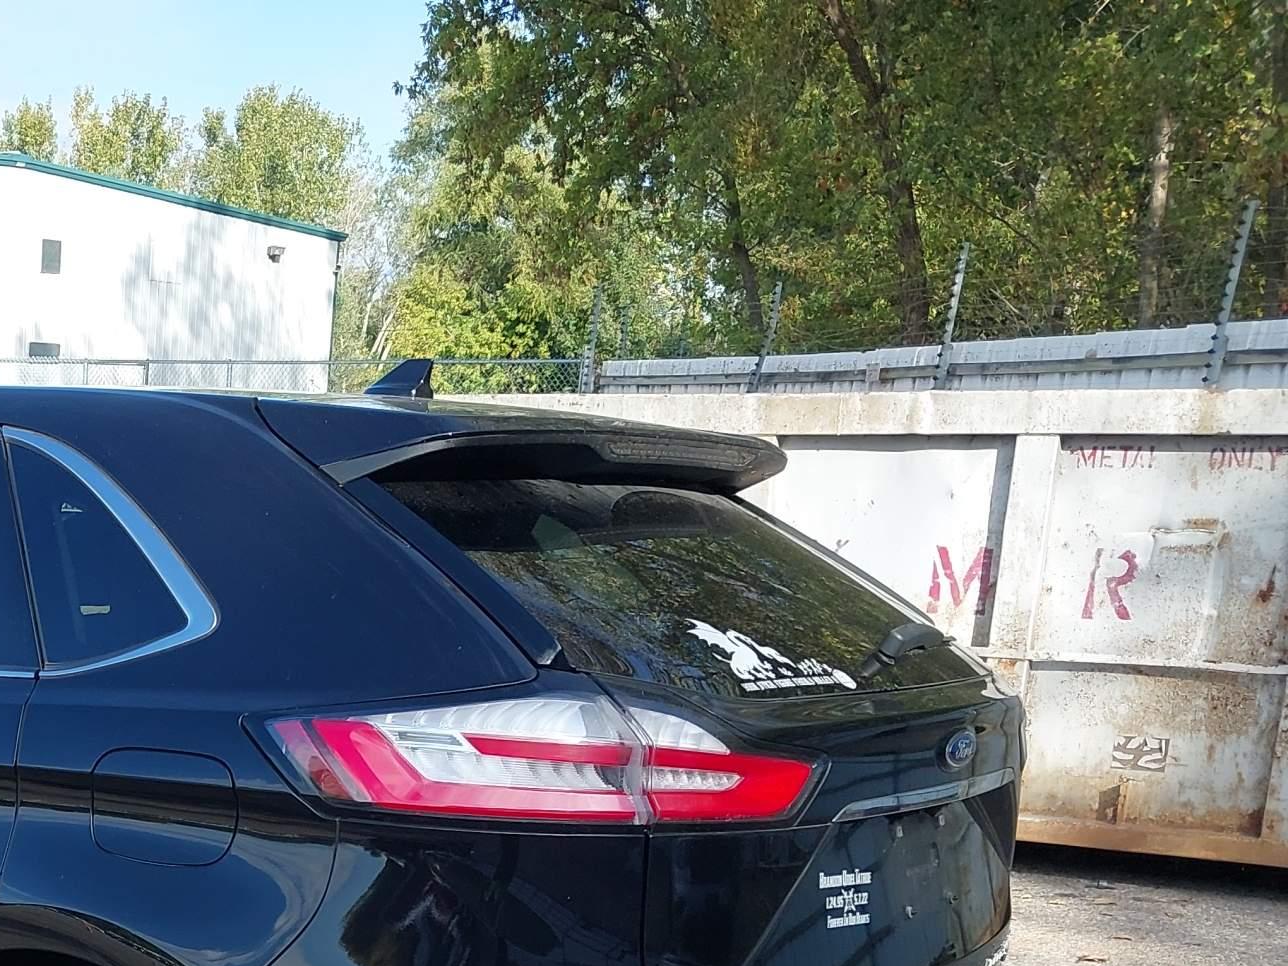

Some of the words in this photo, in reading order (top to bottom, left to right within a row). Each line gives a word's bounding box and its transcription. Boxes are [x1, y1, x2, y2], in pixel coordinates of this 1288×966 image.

[1209, 446, 1281, 472] ONLY
[927, 546, 994, 616] M
[1081, 548, 1138, 620] R
